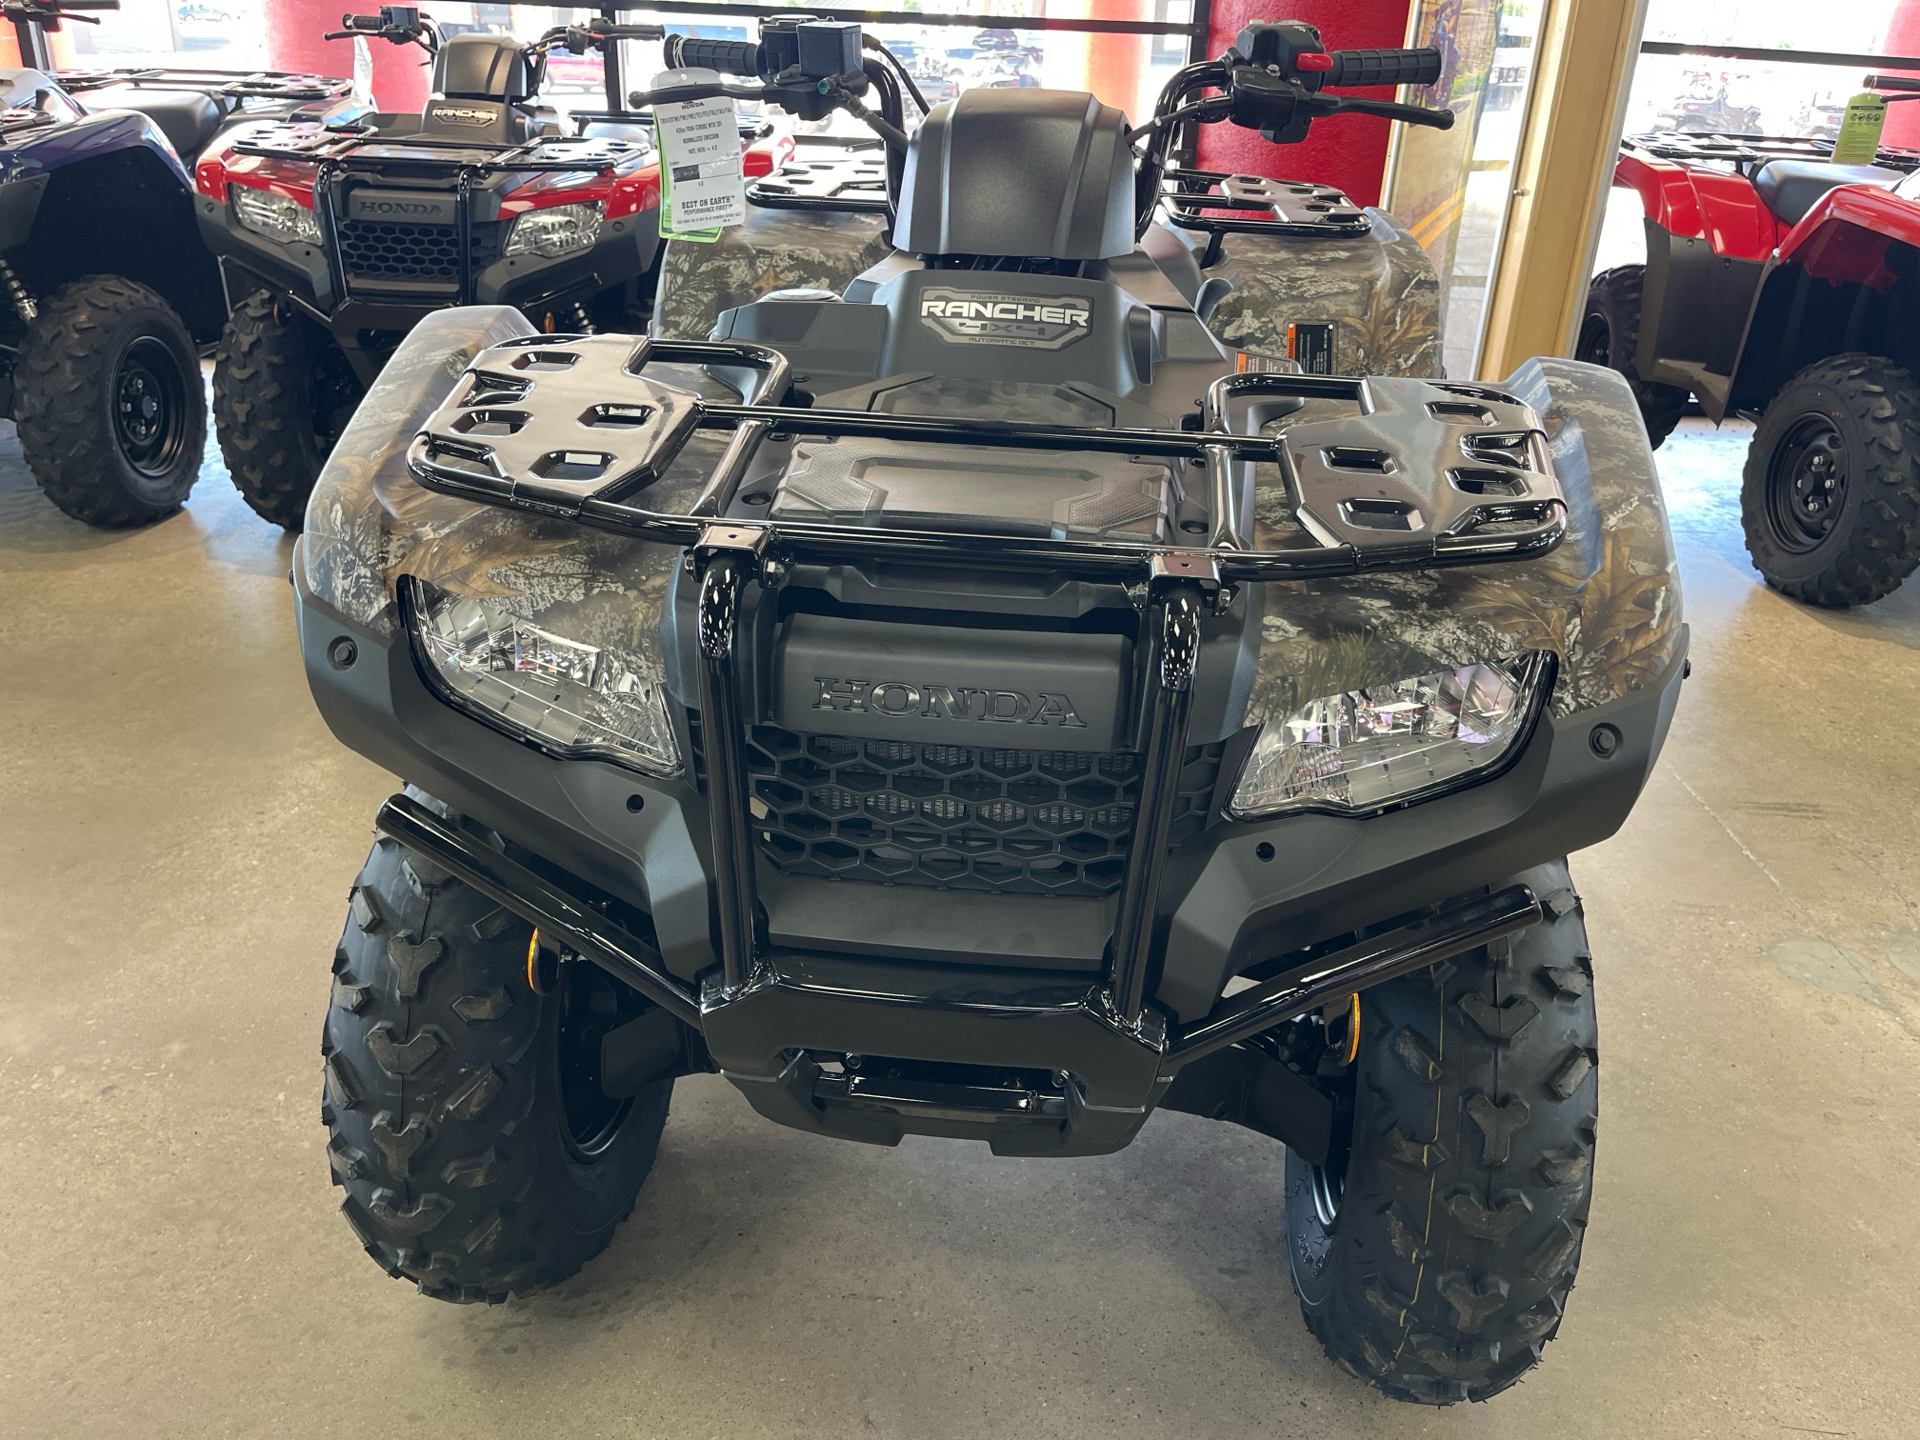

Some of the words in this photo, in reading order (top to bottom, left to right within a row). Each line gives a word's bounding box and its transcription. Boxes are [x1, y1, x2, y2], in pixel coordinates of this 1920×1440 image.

[681, 102, 705, 110] HONDA
[432, 109, 498, 120] RANCHER
[359, 202, 445, 216] HONDA
[681, 200, 698, 210] BEST
[700, 198, 708, 207] ON
[683, 206, 715, 216] PERFORMANCE
[921, 301, 1089, 326] RANCHER
[968, 337, 1016, 346] AUTOMATIC
[811, 676, 1088, 728] HONDA
